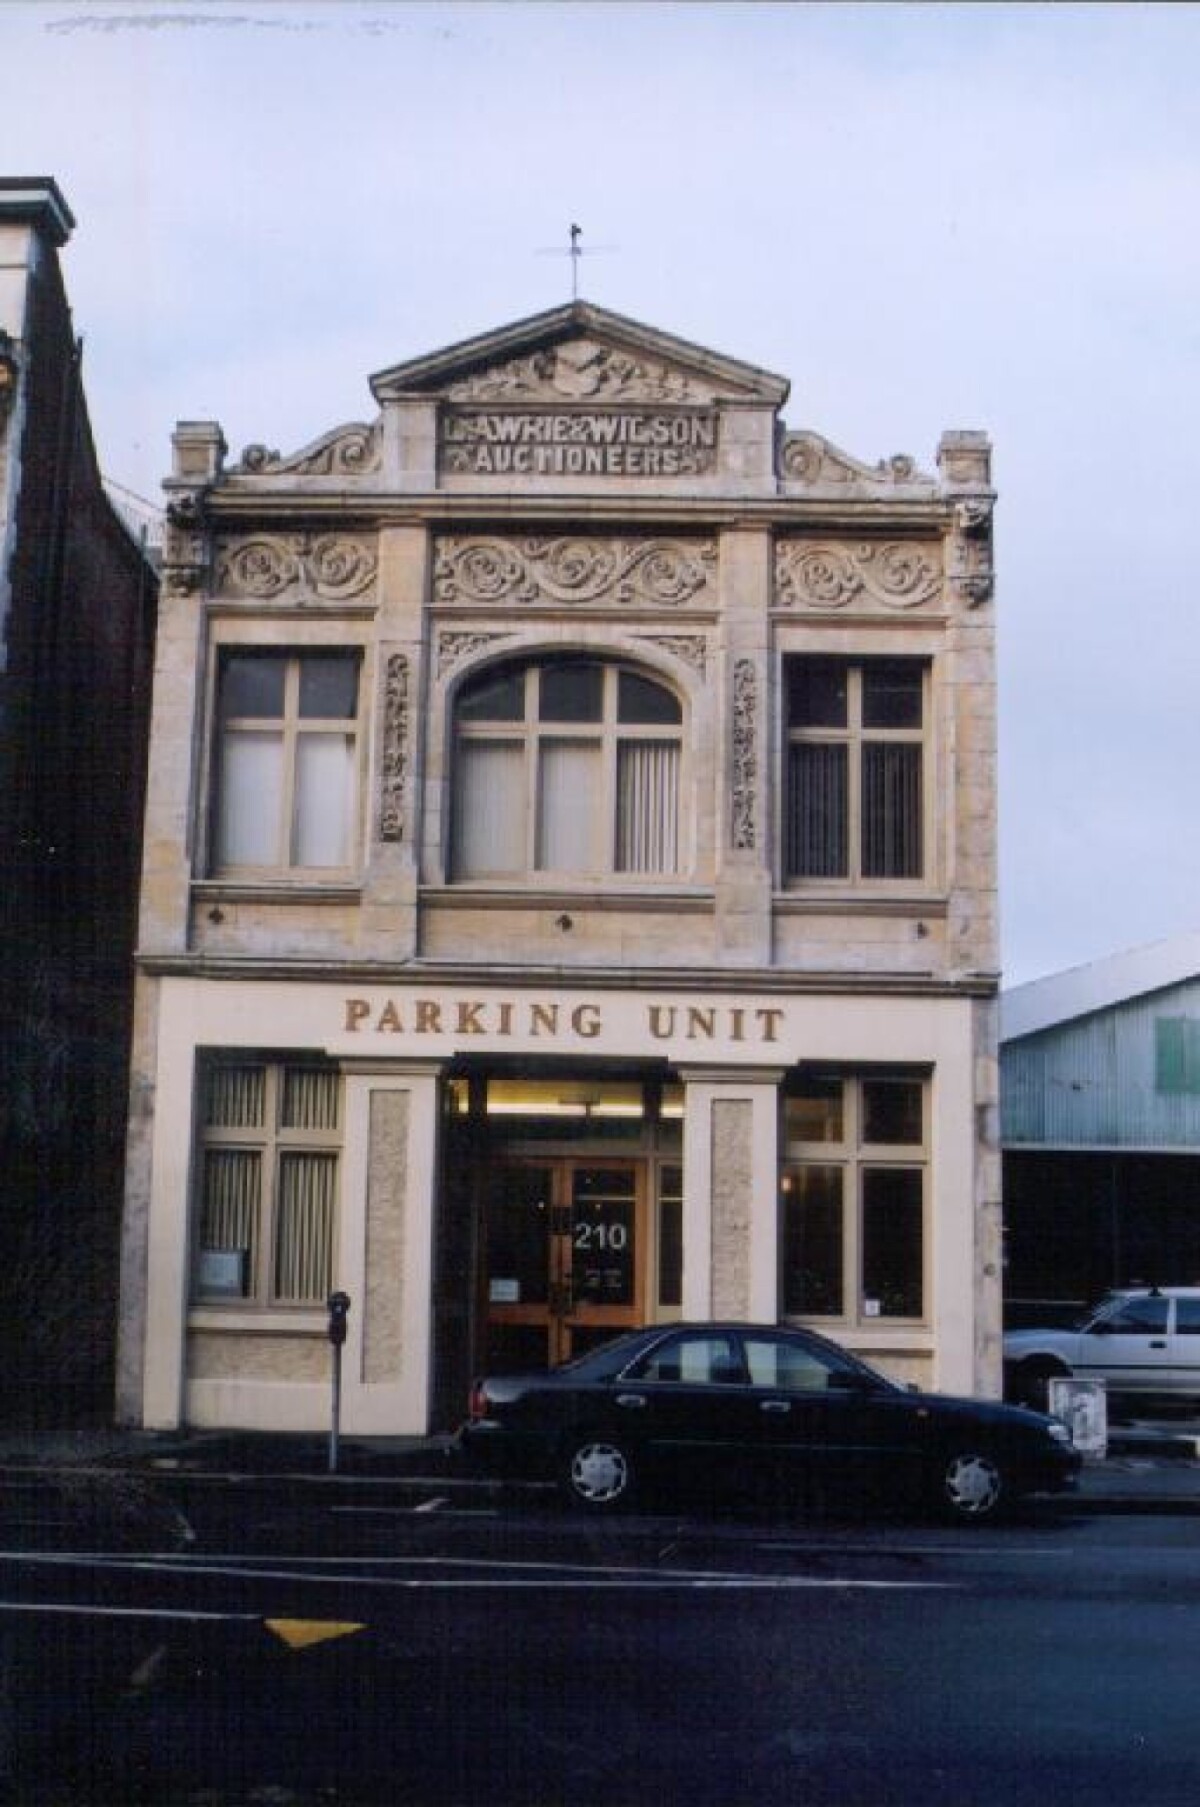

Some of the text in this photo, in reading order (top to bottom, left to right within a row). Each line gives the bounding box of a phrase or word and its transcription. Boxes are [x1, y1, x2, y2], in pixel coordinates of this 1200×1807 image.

[584, 415, 714, 446] WILSON
[474, 445, 678, 473] AUCTIONEERS
[345, 999, 785, 1042] PARKING UNIT
[575, 1223, 627, 1249] 210
